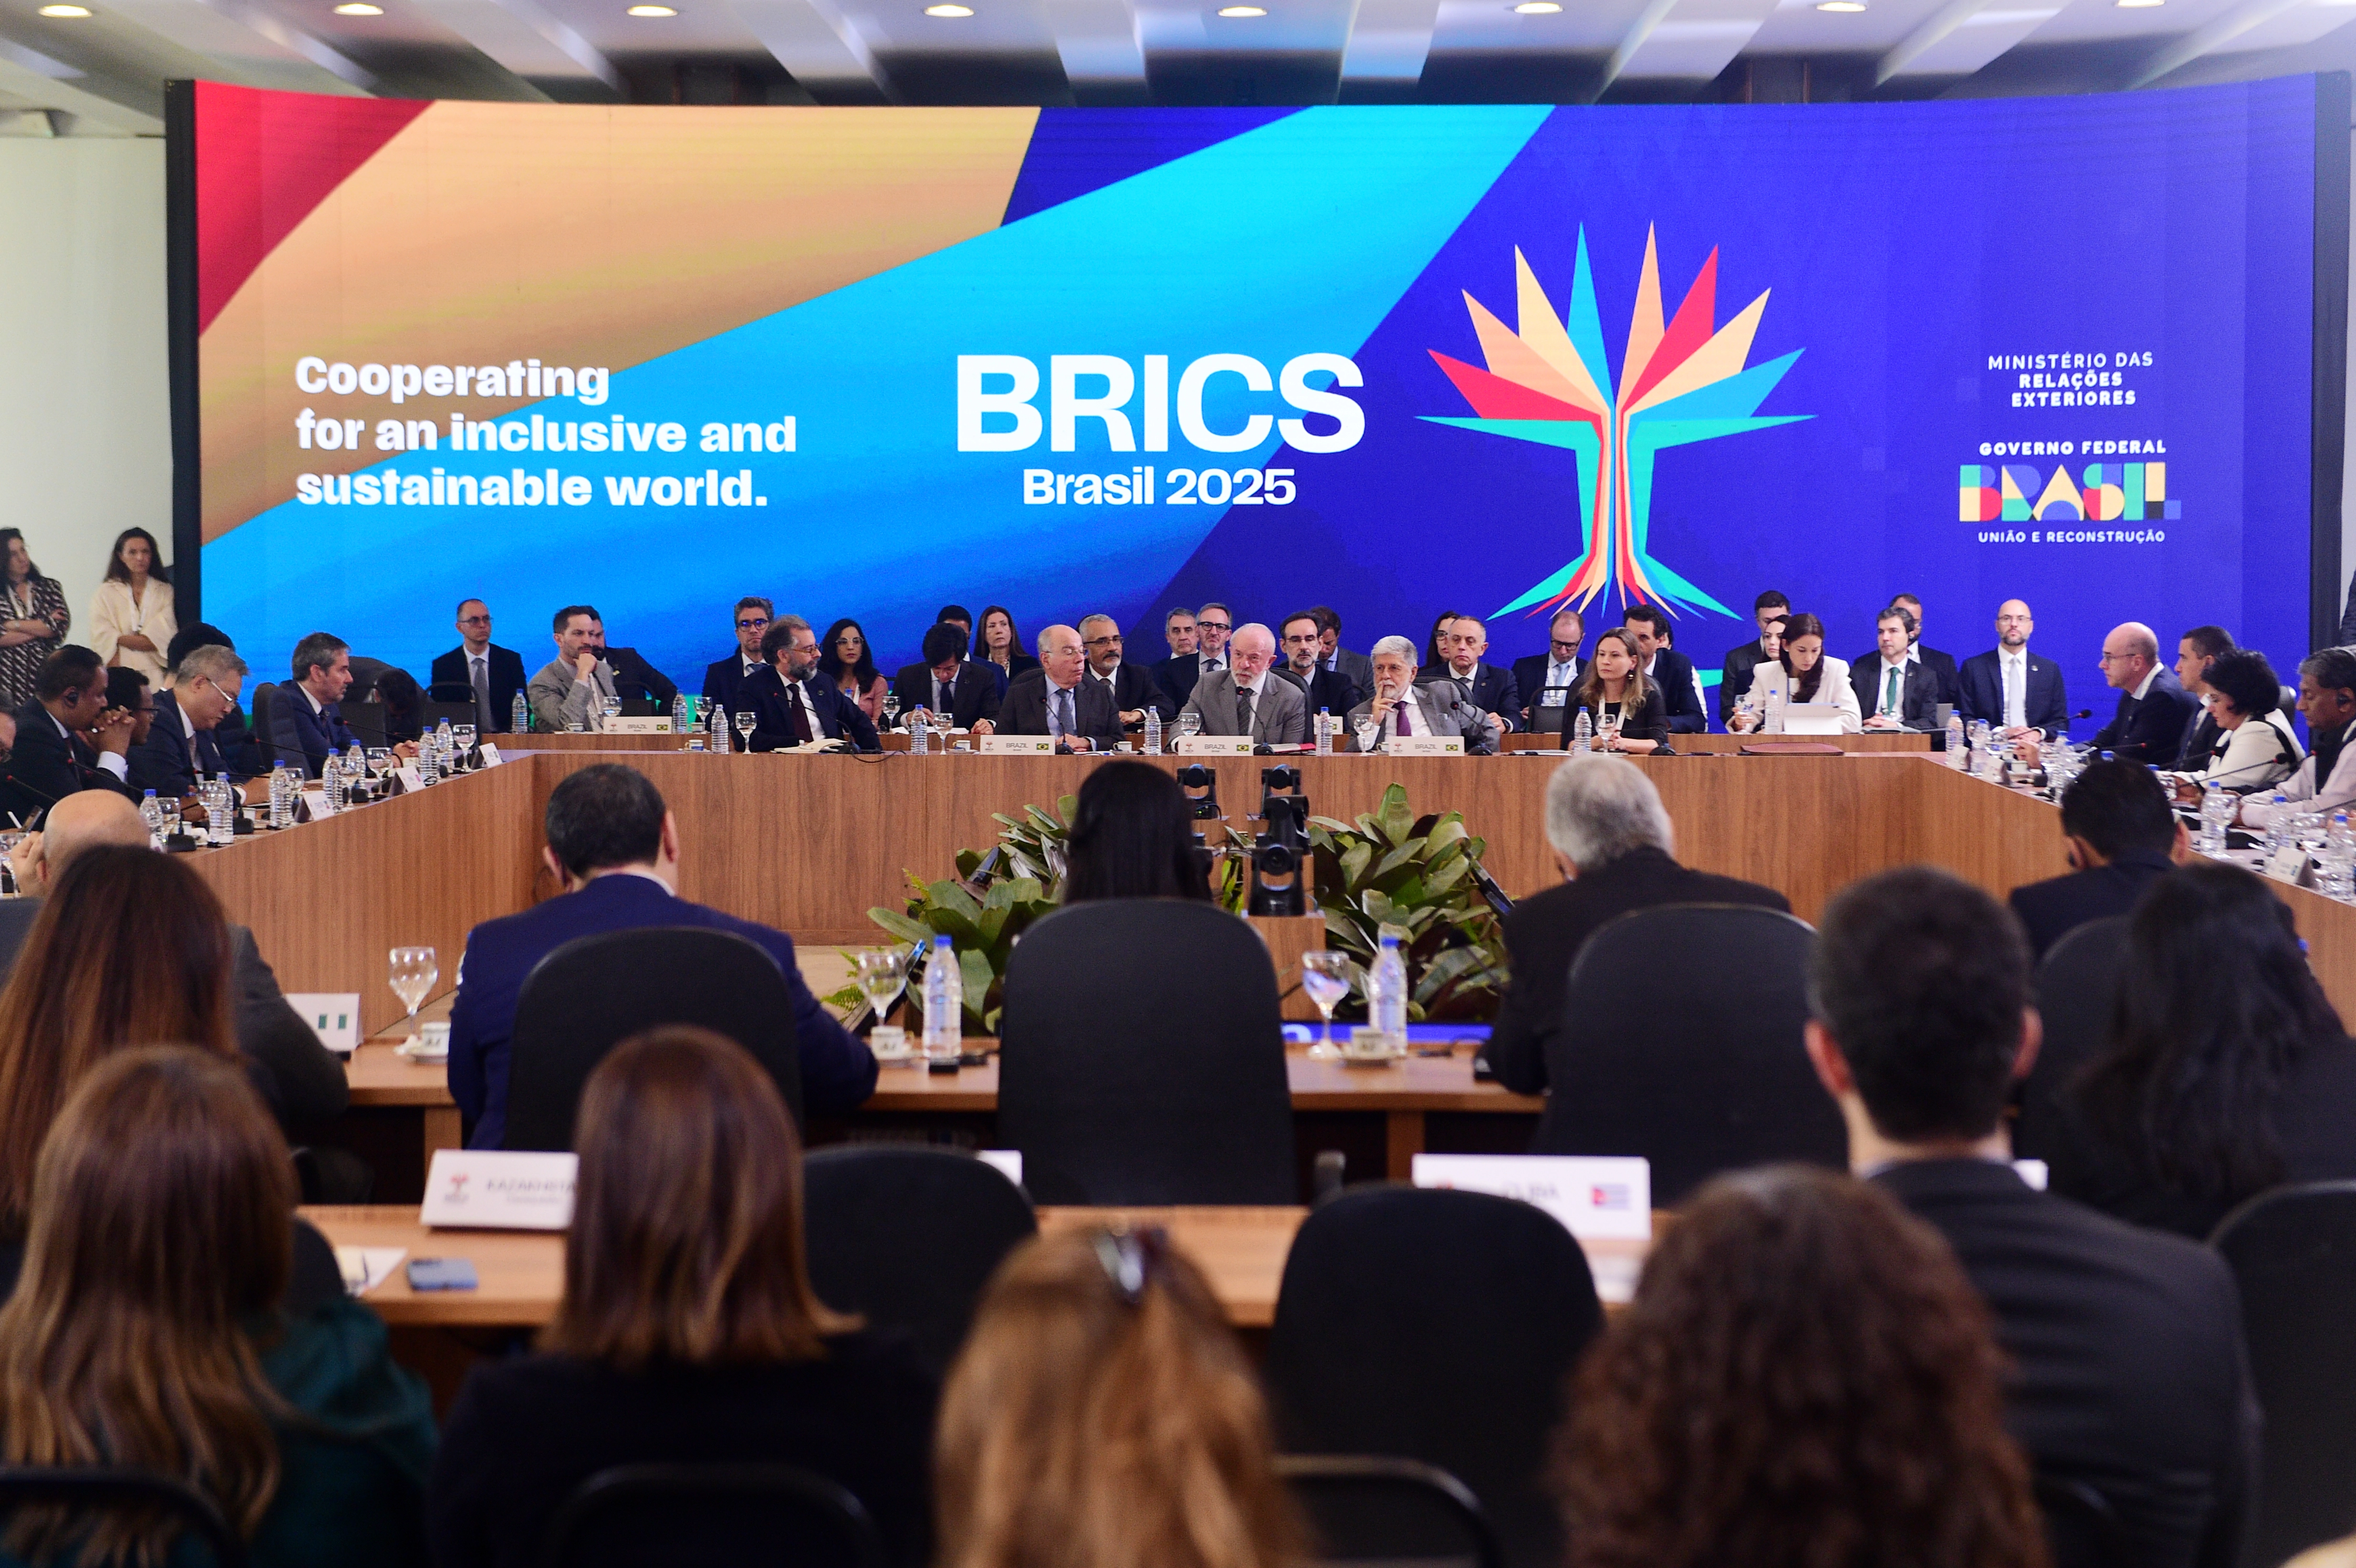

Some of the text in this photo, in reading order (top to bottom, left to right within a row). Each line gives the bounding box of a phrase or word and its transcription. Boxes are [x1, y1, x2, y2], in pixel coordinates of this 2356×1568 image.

[1988, 351, 2153, 370] MINISTÉRIO DAS
[295, 356, 609, 405] Cooperating
[2011, 390, 2136, 407] EXTERIORES
[2019, 369, 2123, 391] RELAÇÕES
[957, 353, 1365, 453] BRICS
[295, 407, 796, 452] for an inclusive and
[1979, 440, 2166, 456] GOVERNO FEDERAL
[296, 468, 767, 506] sustainable world.
[1024, 466, 1296, 505] Brasil 2025
[1959, 462, 2181, 522] BRASIL
[1978, 530, 2165, 544] UNIÃO E RECONSTRUÇÃO
